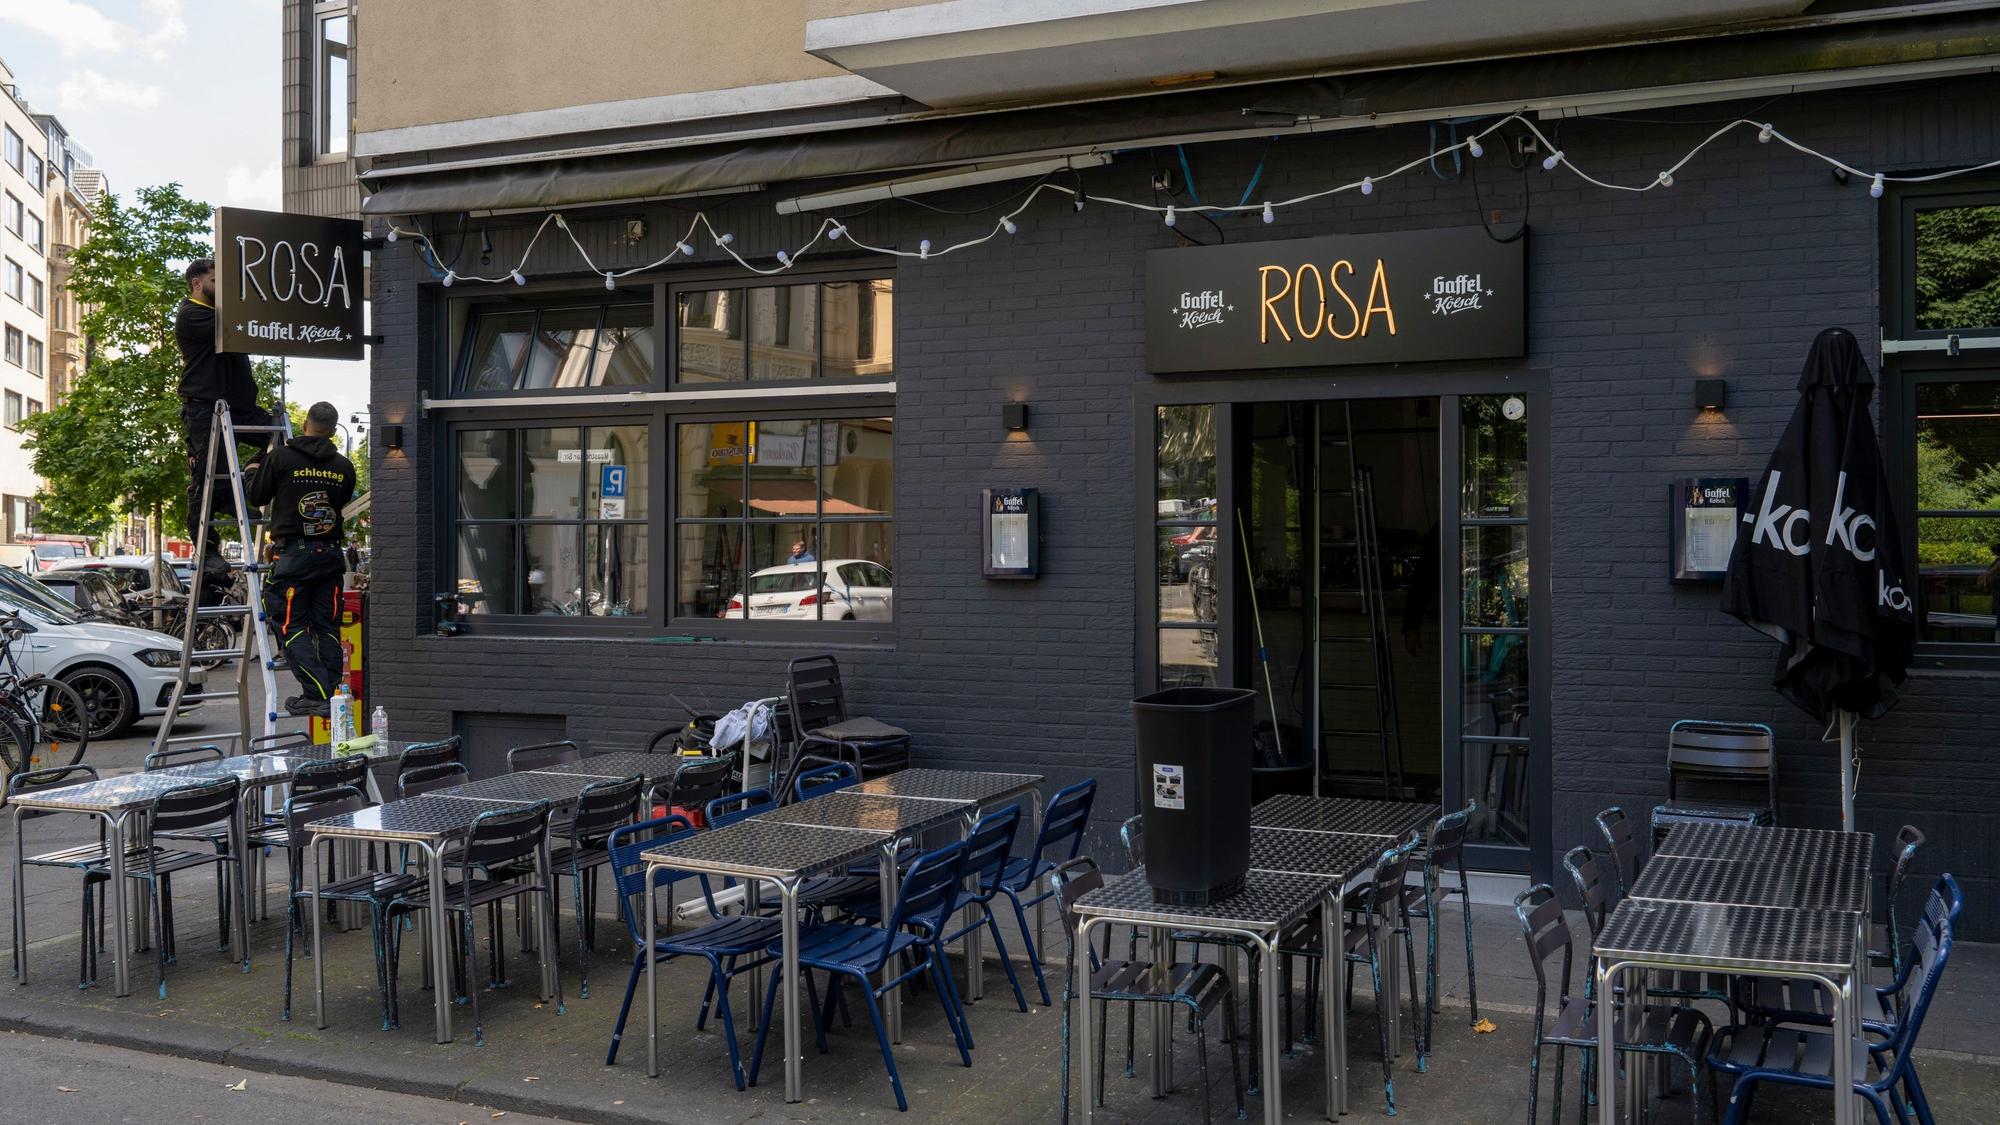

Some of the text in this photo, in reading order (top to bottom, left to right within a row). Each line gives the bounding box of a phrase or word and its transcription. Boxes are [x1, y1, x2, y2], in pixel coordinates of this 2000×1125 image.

[236, 235, 350, 309] ROSA
[1433, 273, 1483, 295] Gaffel
[1180, 290, 1224, 310] Gaffel
[1258, 257, 1396, 344] ROSA
[1431, 295, 1482, 316] Kölsch
[1178, 308, 1224, 329] Kölsch
[247, 319, 344, 343] Gaffel Kölsch
[293, 468, 344, 483] schlottag
[1003, 496, 1023, 506] Gaffel
[1704, 487, 1731, 498] Gaffel
